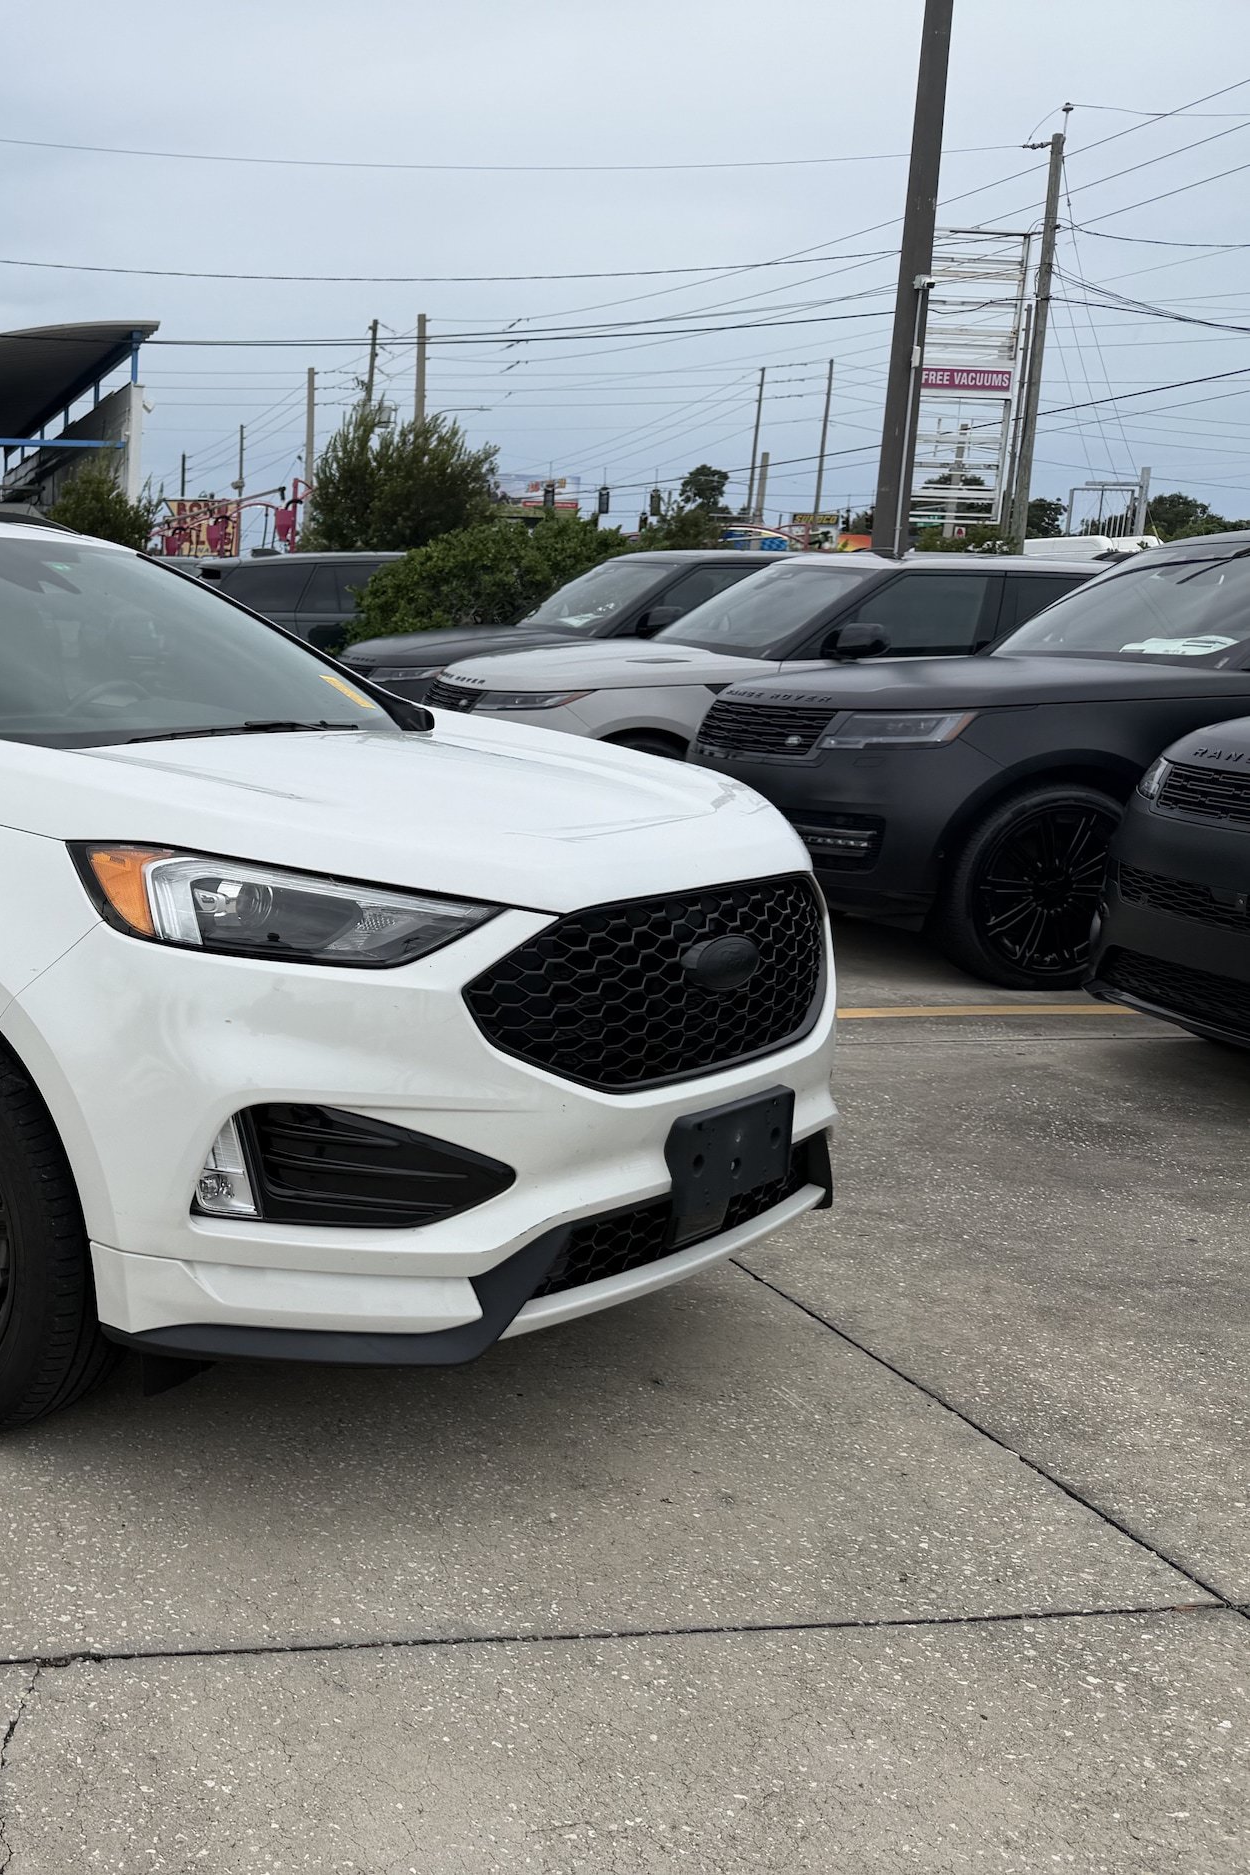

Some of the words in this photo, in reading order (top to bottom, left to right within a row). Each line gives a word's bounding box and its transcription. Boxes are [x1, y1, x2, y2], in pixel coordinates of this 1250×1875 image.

[921, 371, 950, 384] FREE
[954, 372, 1010, 387] VACUUMS
[794, 514, 838, 524] SUNOCO
[455, 676, 486, 684] ROVER
[726, 690, 765, 699] RANGE
[770, 693, 832, 703] ROVER
